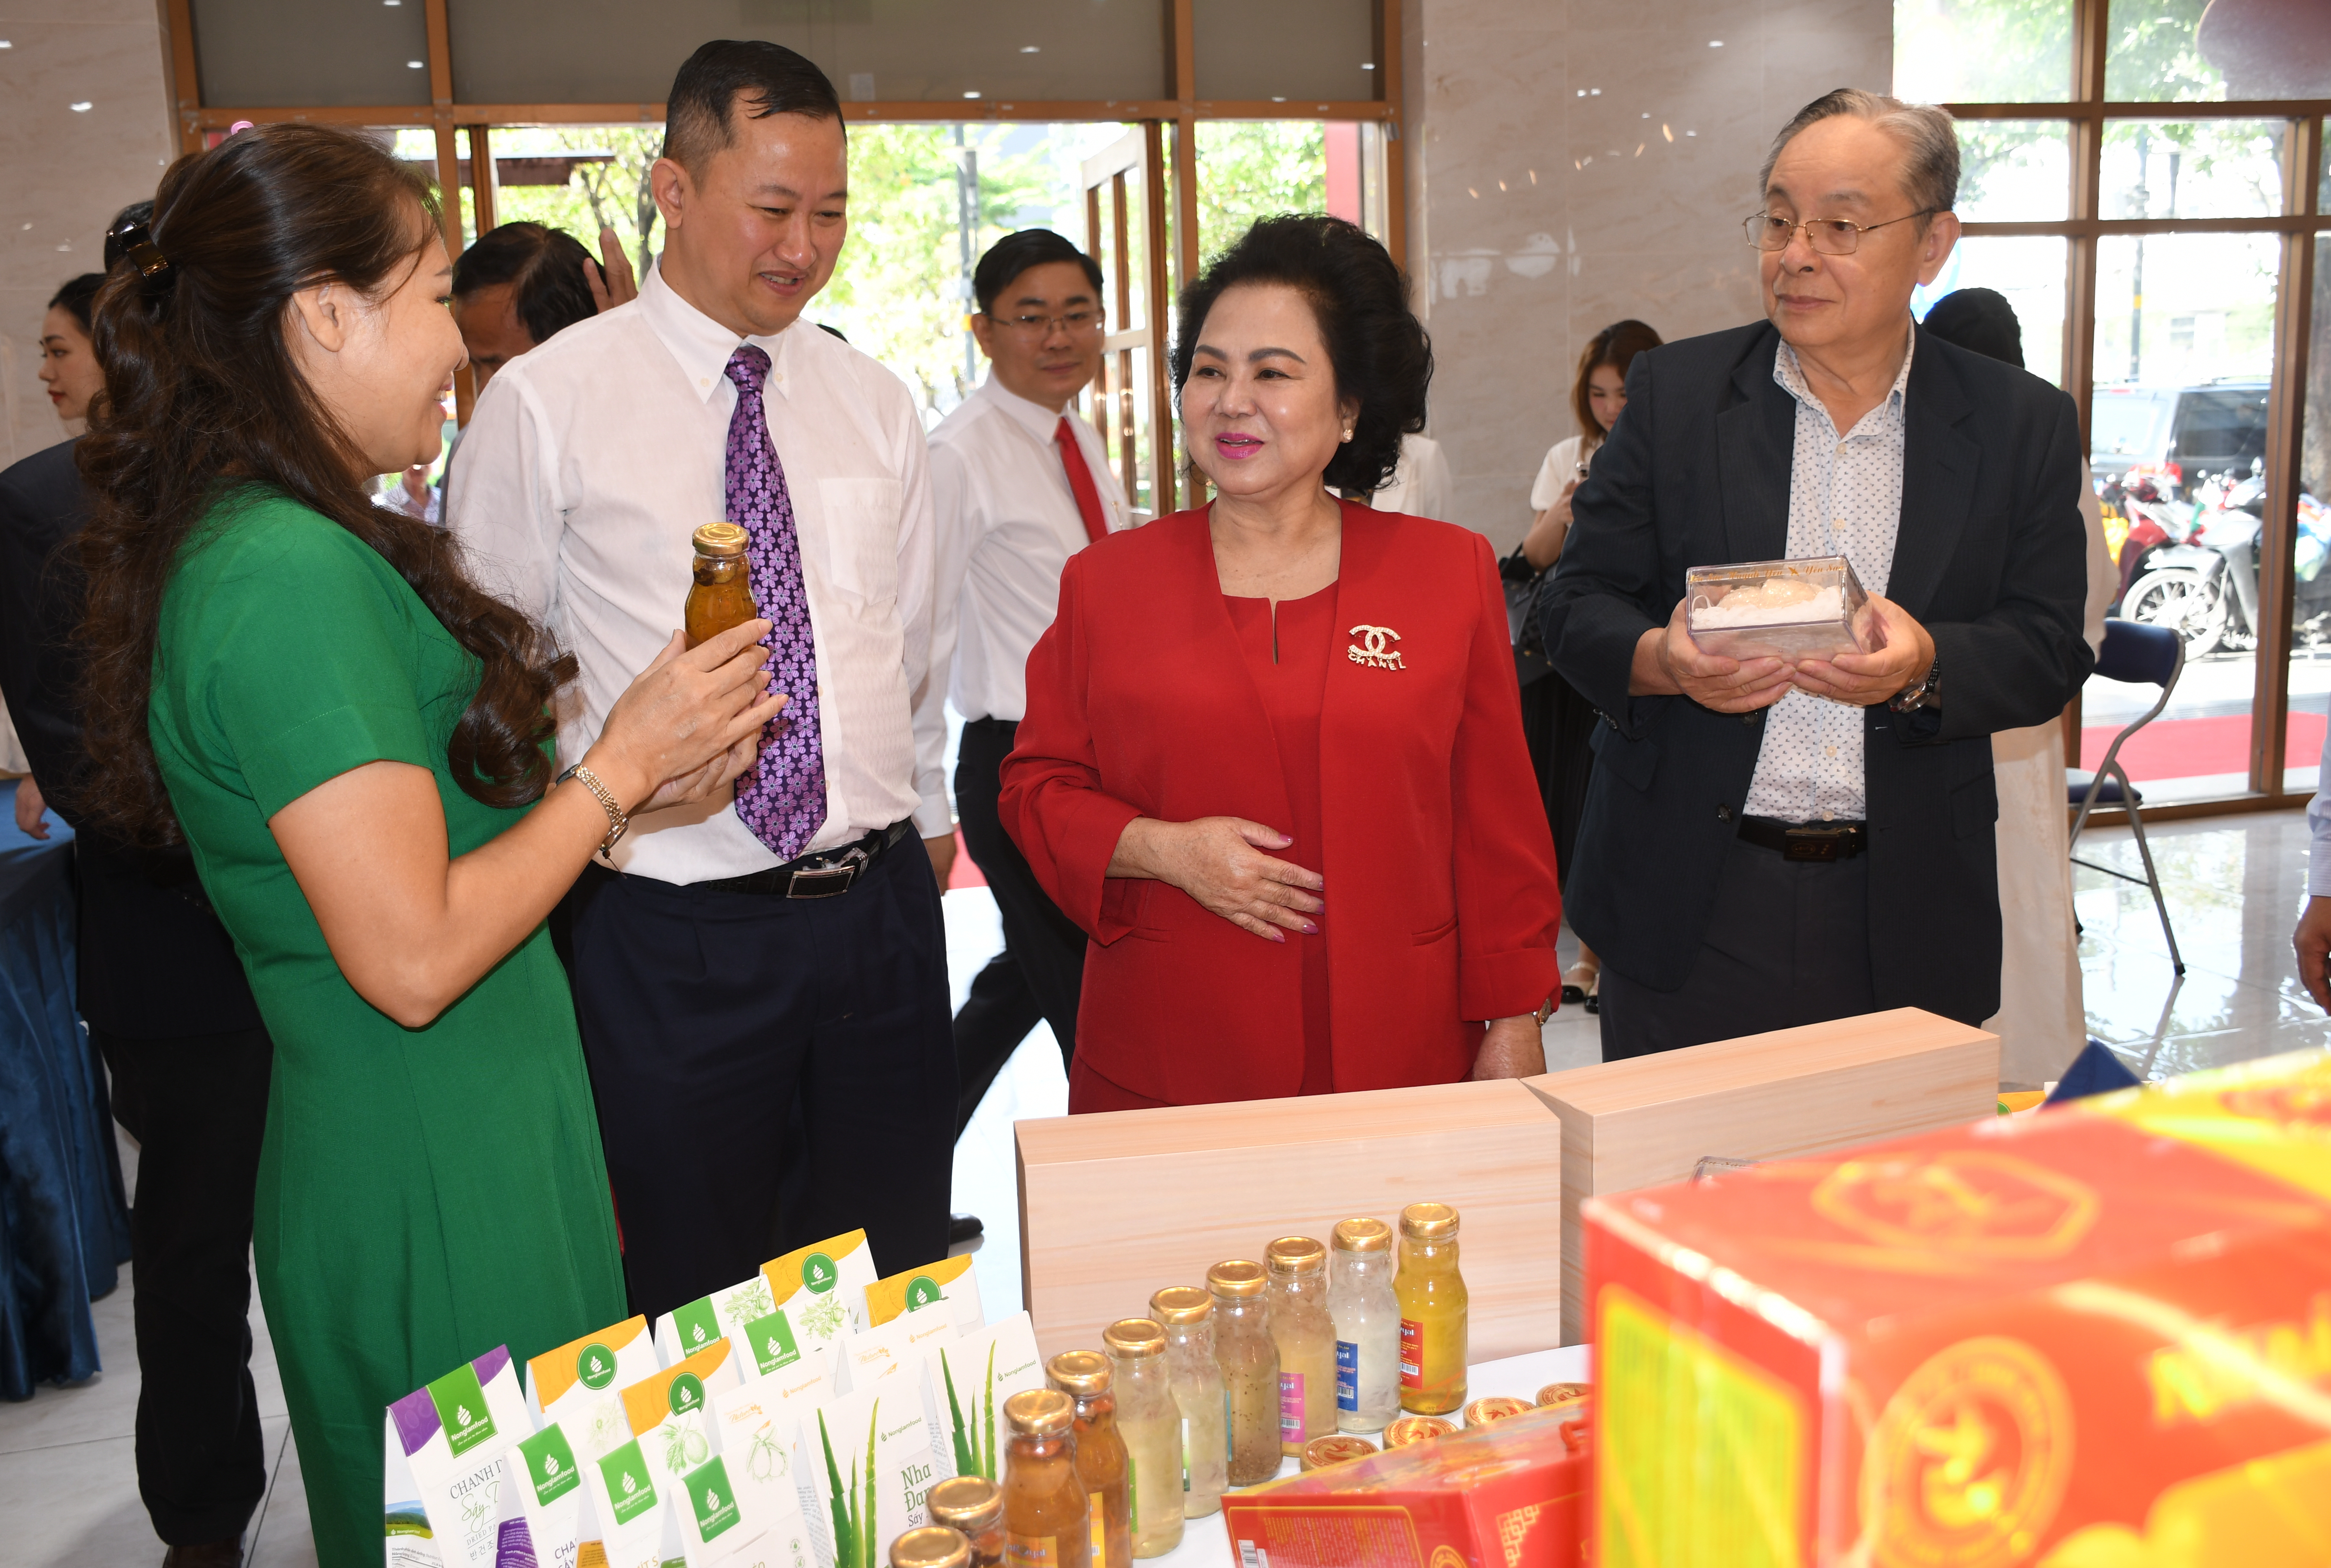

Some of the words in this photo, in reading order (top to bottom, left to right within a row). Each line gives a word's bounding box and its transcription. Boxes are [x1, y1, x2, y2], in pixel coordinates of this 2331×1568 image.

[1348, 652, 1406, 670] CHANEL
[916, 1323, 947, 1339] Nonglamfood
[686, 1336, 720, 1355] Nonglamfood
[760, 1349, 796, 1369] Nonglamfood
[1004, 1359, 1036, 1377] Nonglamfood
[790, 1375, 821, 1394] Nonglamfood
[451, 1415, 489, 1441] Nonglamfood
[888, 1416, 922, 1437] Nonglamfood
[450, 1464, 495, 1499] CHANH
[537, 1465, 575, 1492] Nonglamfood
[901, 1463, 932, 1490] Nha
[615, 1484, 652, 1510] Nonglamfood
[700, 1500, 734, 1528] Nonglamfood
[908, 1510, 923, 1527] Sấy
[467, 1529, 487, 1546] DRIED
[554, 1538, 577, 1559] CHA
